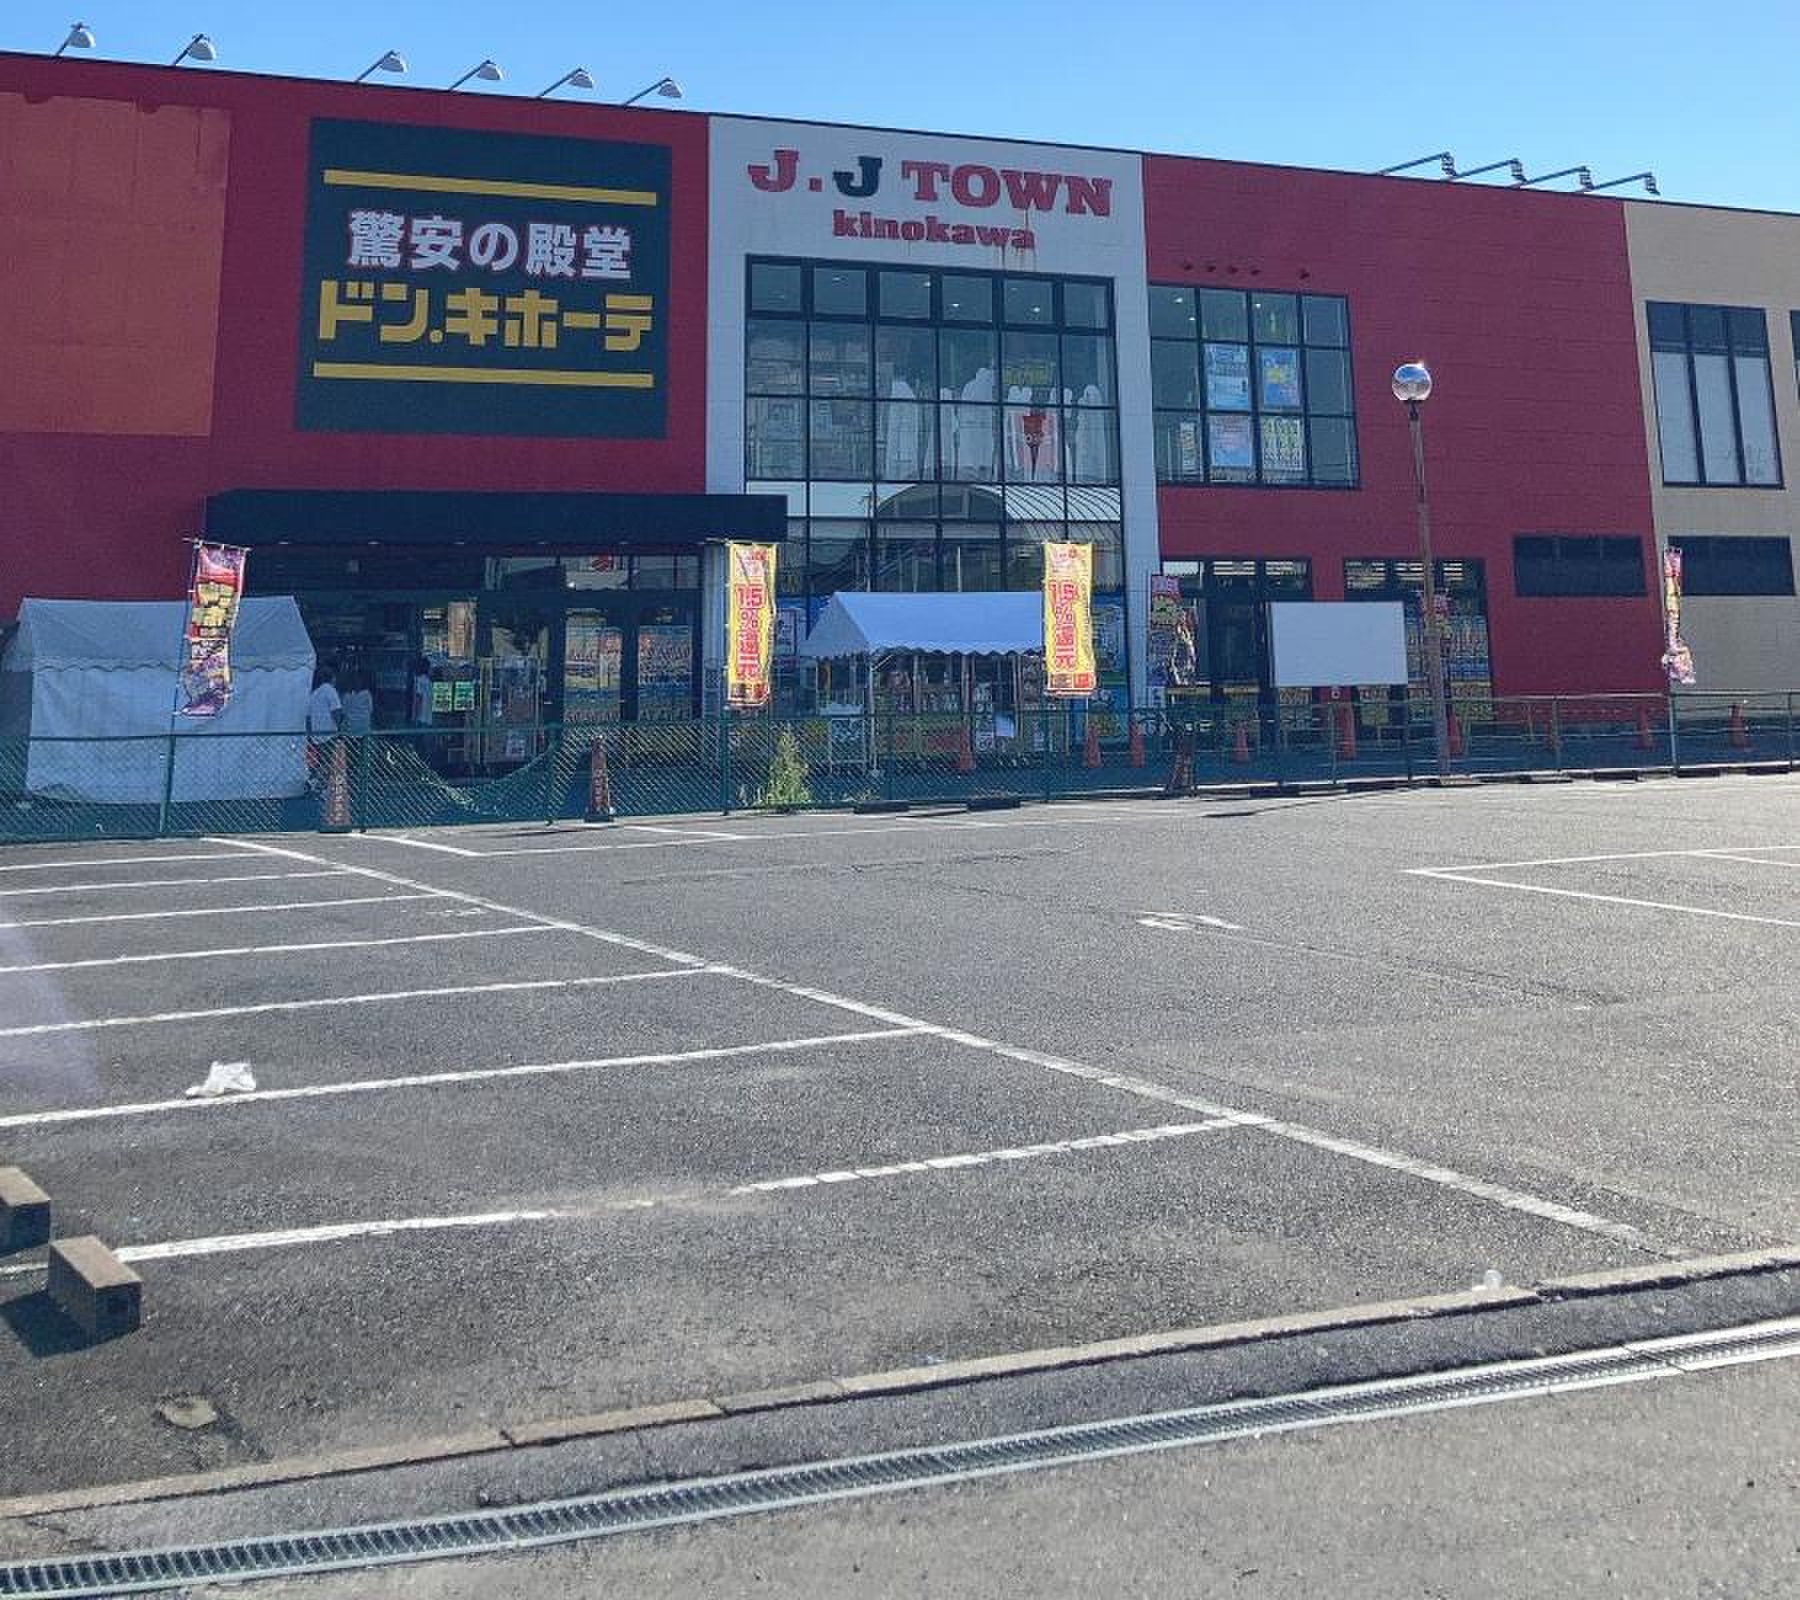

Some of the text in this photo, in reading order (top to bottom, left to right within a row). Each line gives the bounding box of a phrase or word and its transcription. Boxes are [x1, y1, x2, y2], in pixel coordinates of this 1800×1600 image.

[748, 149, 1113, 217] J.J TOWN
[348, 208, 632, 279] 驚安の殿堂
[832, 208, 1035, 249] kinokawa
